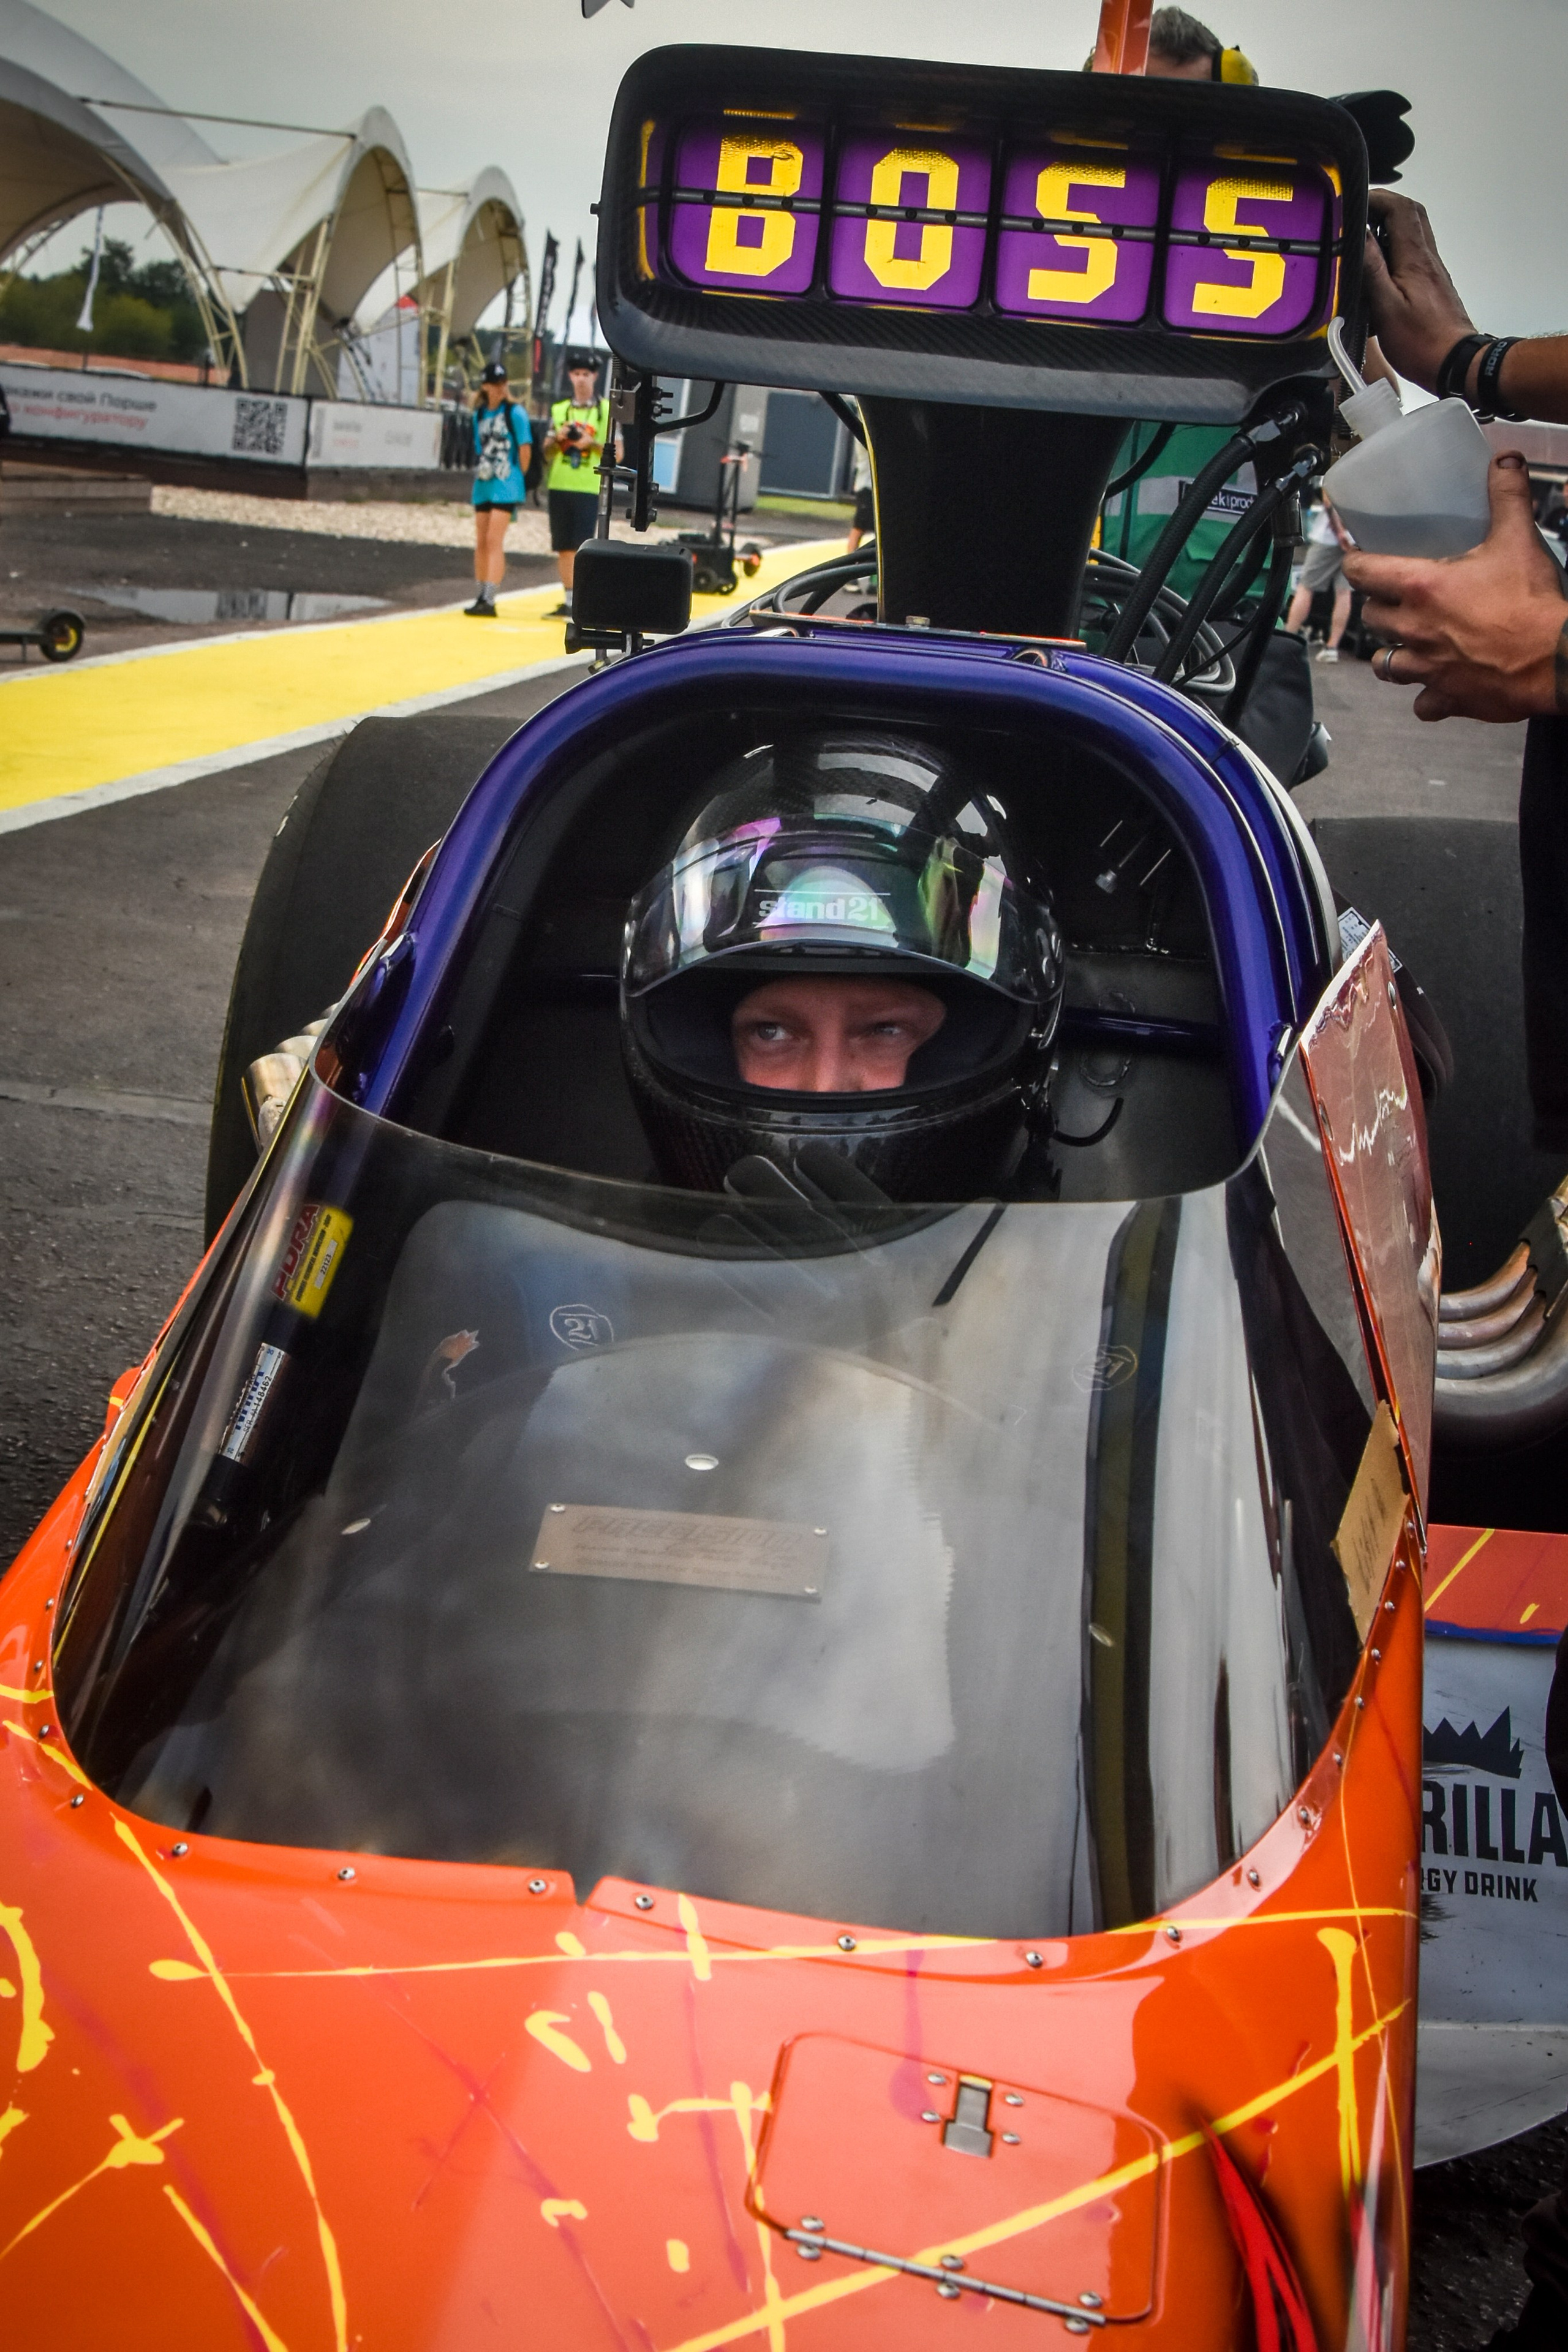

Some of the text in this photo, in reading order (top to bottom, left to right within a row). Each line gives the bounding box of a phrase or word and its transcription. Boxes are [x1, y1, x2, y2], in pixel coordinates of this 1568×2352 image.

[705, 134, 1294, 319] BOSS
[758, 896, 880, 921] stand21
[269, 1204, 320, 1302] PDRA
[320, 1254, 332, 1275] 22123
[565, 1317, 598, 1341] 21
[1422, 1780, 1568, 1868] RILLA
[1421, 1868, 1539, 1903] GY DRINK
